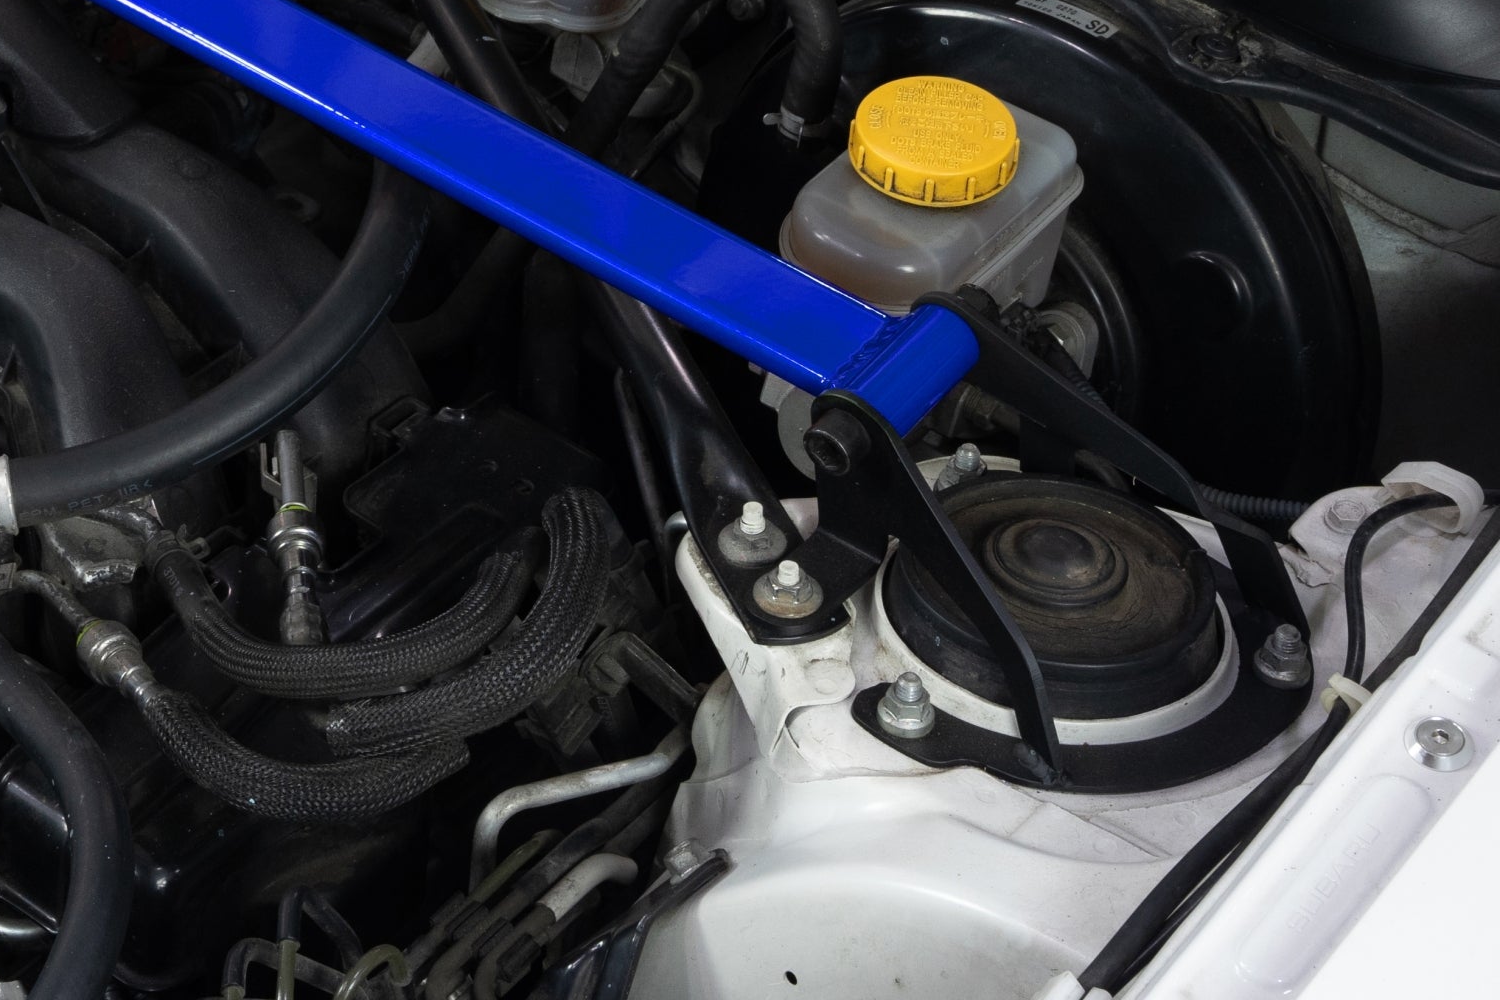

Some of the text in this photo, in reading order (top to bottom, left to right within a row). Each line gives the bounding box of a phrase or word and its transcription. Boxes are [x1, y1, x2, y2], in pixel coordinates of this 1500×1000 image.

[1085, 19, 1110, 35] SD
[897, 86, 926, 98] CLEAN
[918, 81, 965, 93] WARNING
[896, 94, 984, 112] BEFORE REMOVING
[913, 129, 962, 142] USE ONLY
[955, 142, 982, 153] FLUID
[910, 156, 960, 169] CONTAINER
